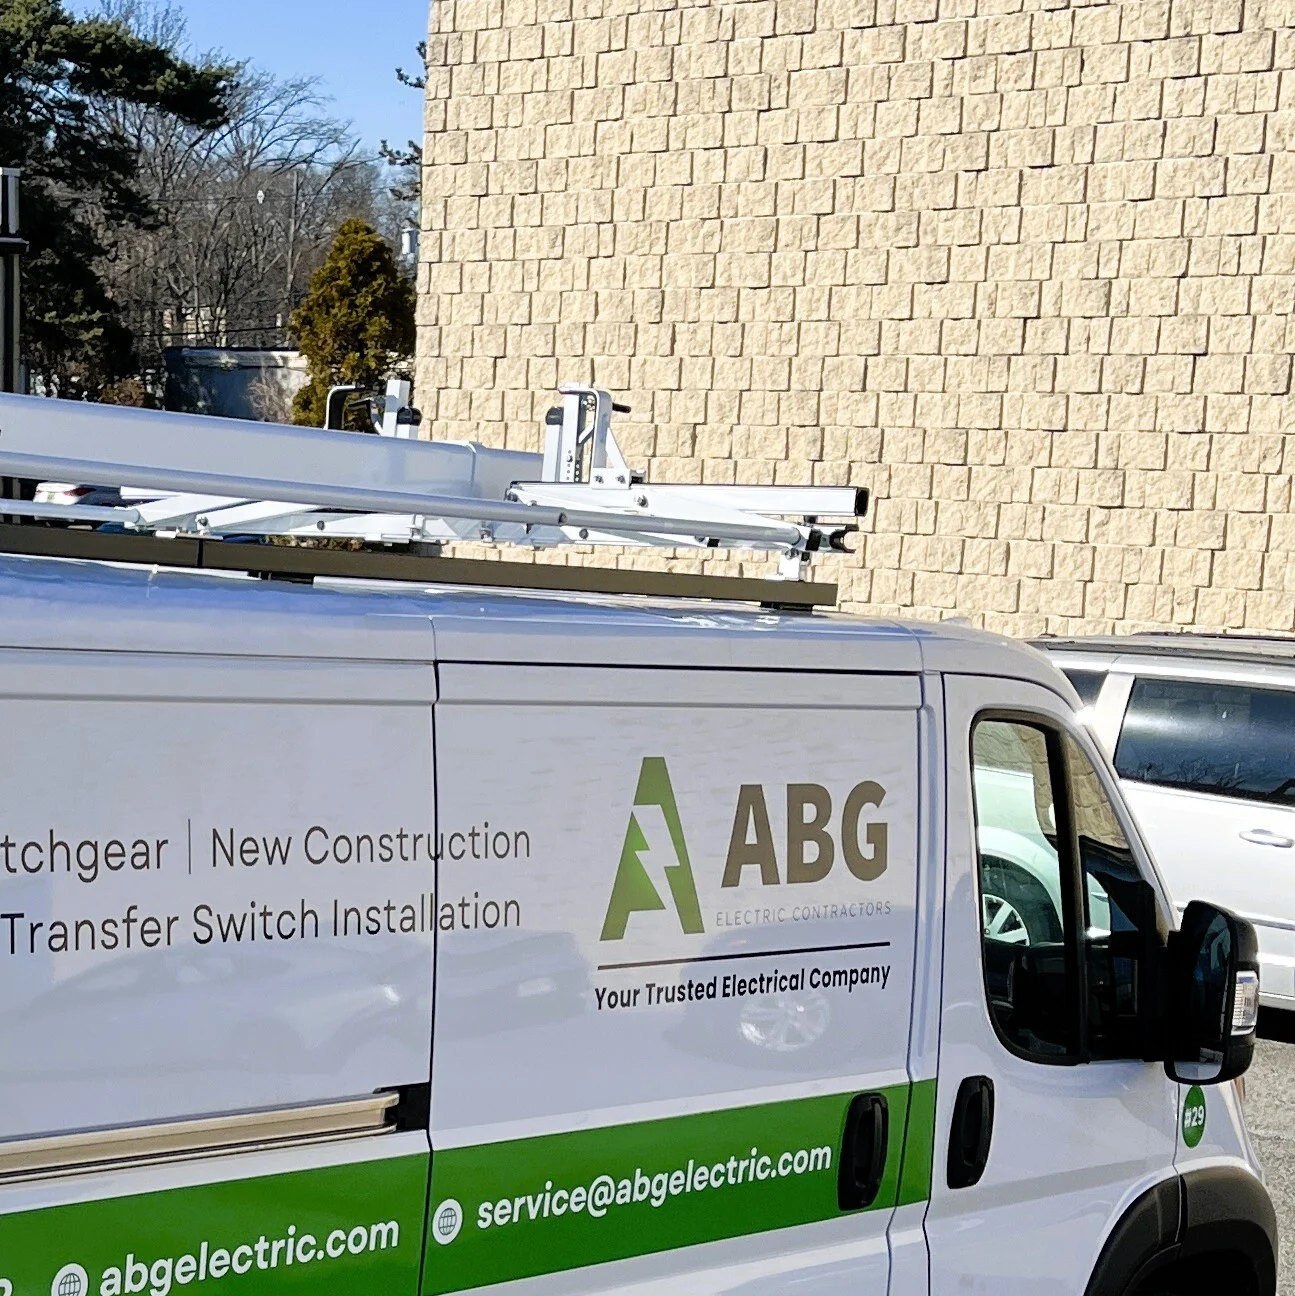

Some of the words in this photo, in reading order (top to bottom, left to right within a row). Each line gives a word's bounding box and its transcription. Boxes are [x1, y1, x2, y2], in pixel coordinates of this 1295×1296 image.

[211, 827, 292, 868] New
[304, 821, 531, 866] Construction
[721, 780, 888, 888] ABG
[0, 904, 179, 955] Transfer
[192, 898, 318, 945] Switch
[333, 891, 521, 937] Installation
[716, 905, 785, 926] ELECTRIC
[793, 900, 891, 922] CONTRACTORS
[594, 987, 640, 1010] Your
[645, 976, 716, 1005] Trusted
[722, 968, 805, 998] Electrical
[809, 965, 891, 992] Company
[1184, 1105, 1204, 1128] #29
[477, 1145, 832, 1229] service@abgelectric.com
